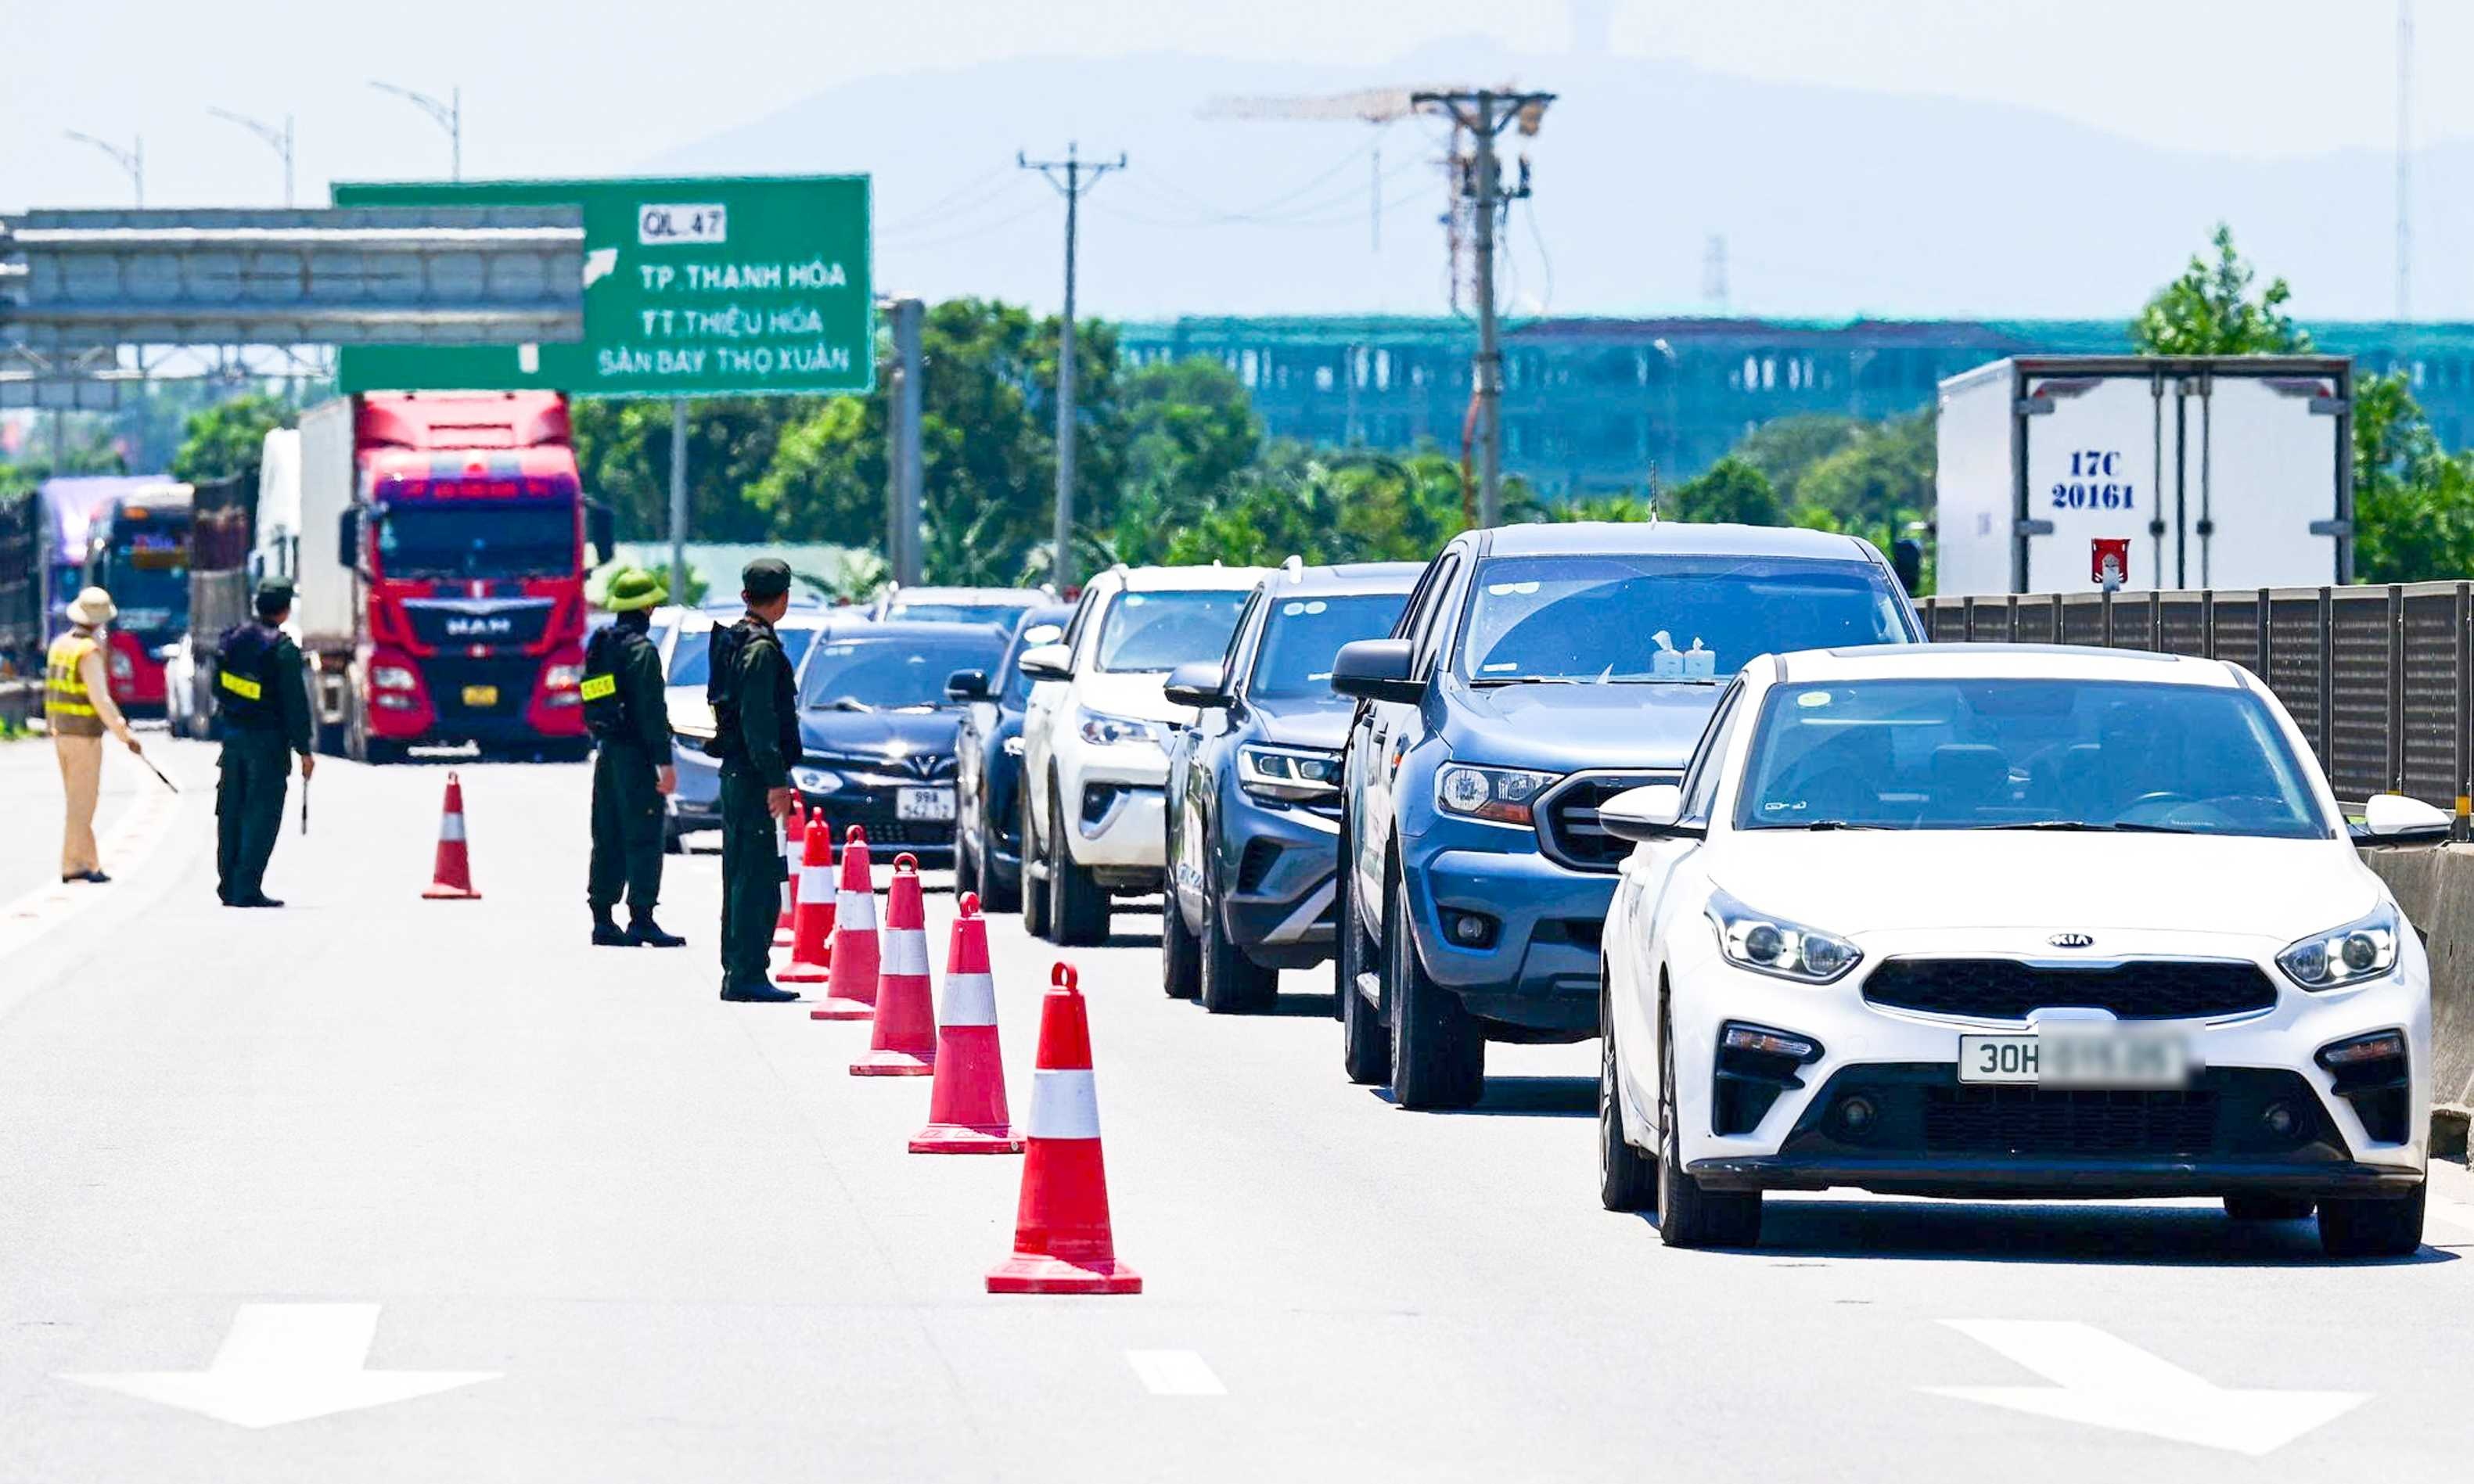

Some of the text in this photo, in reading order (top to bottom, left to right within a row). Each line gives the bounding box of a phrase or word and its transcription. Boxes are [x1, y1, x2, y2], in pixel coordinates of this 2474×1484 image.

[2069, 451, 2120, 477] 17C
[2051, 483, 2134, 509] 20161
[446, 618, 511, 635] MAN
[2051, 933, 2090, 945] KIA
[1980, 1043, 2039, 1073] 30H
